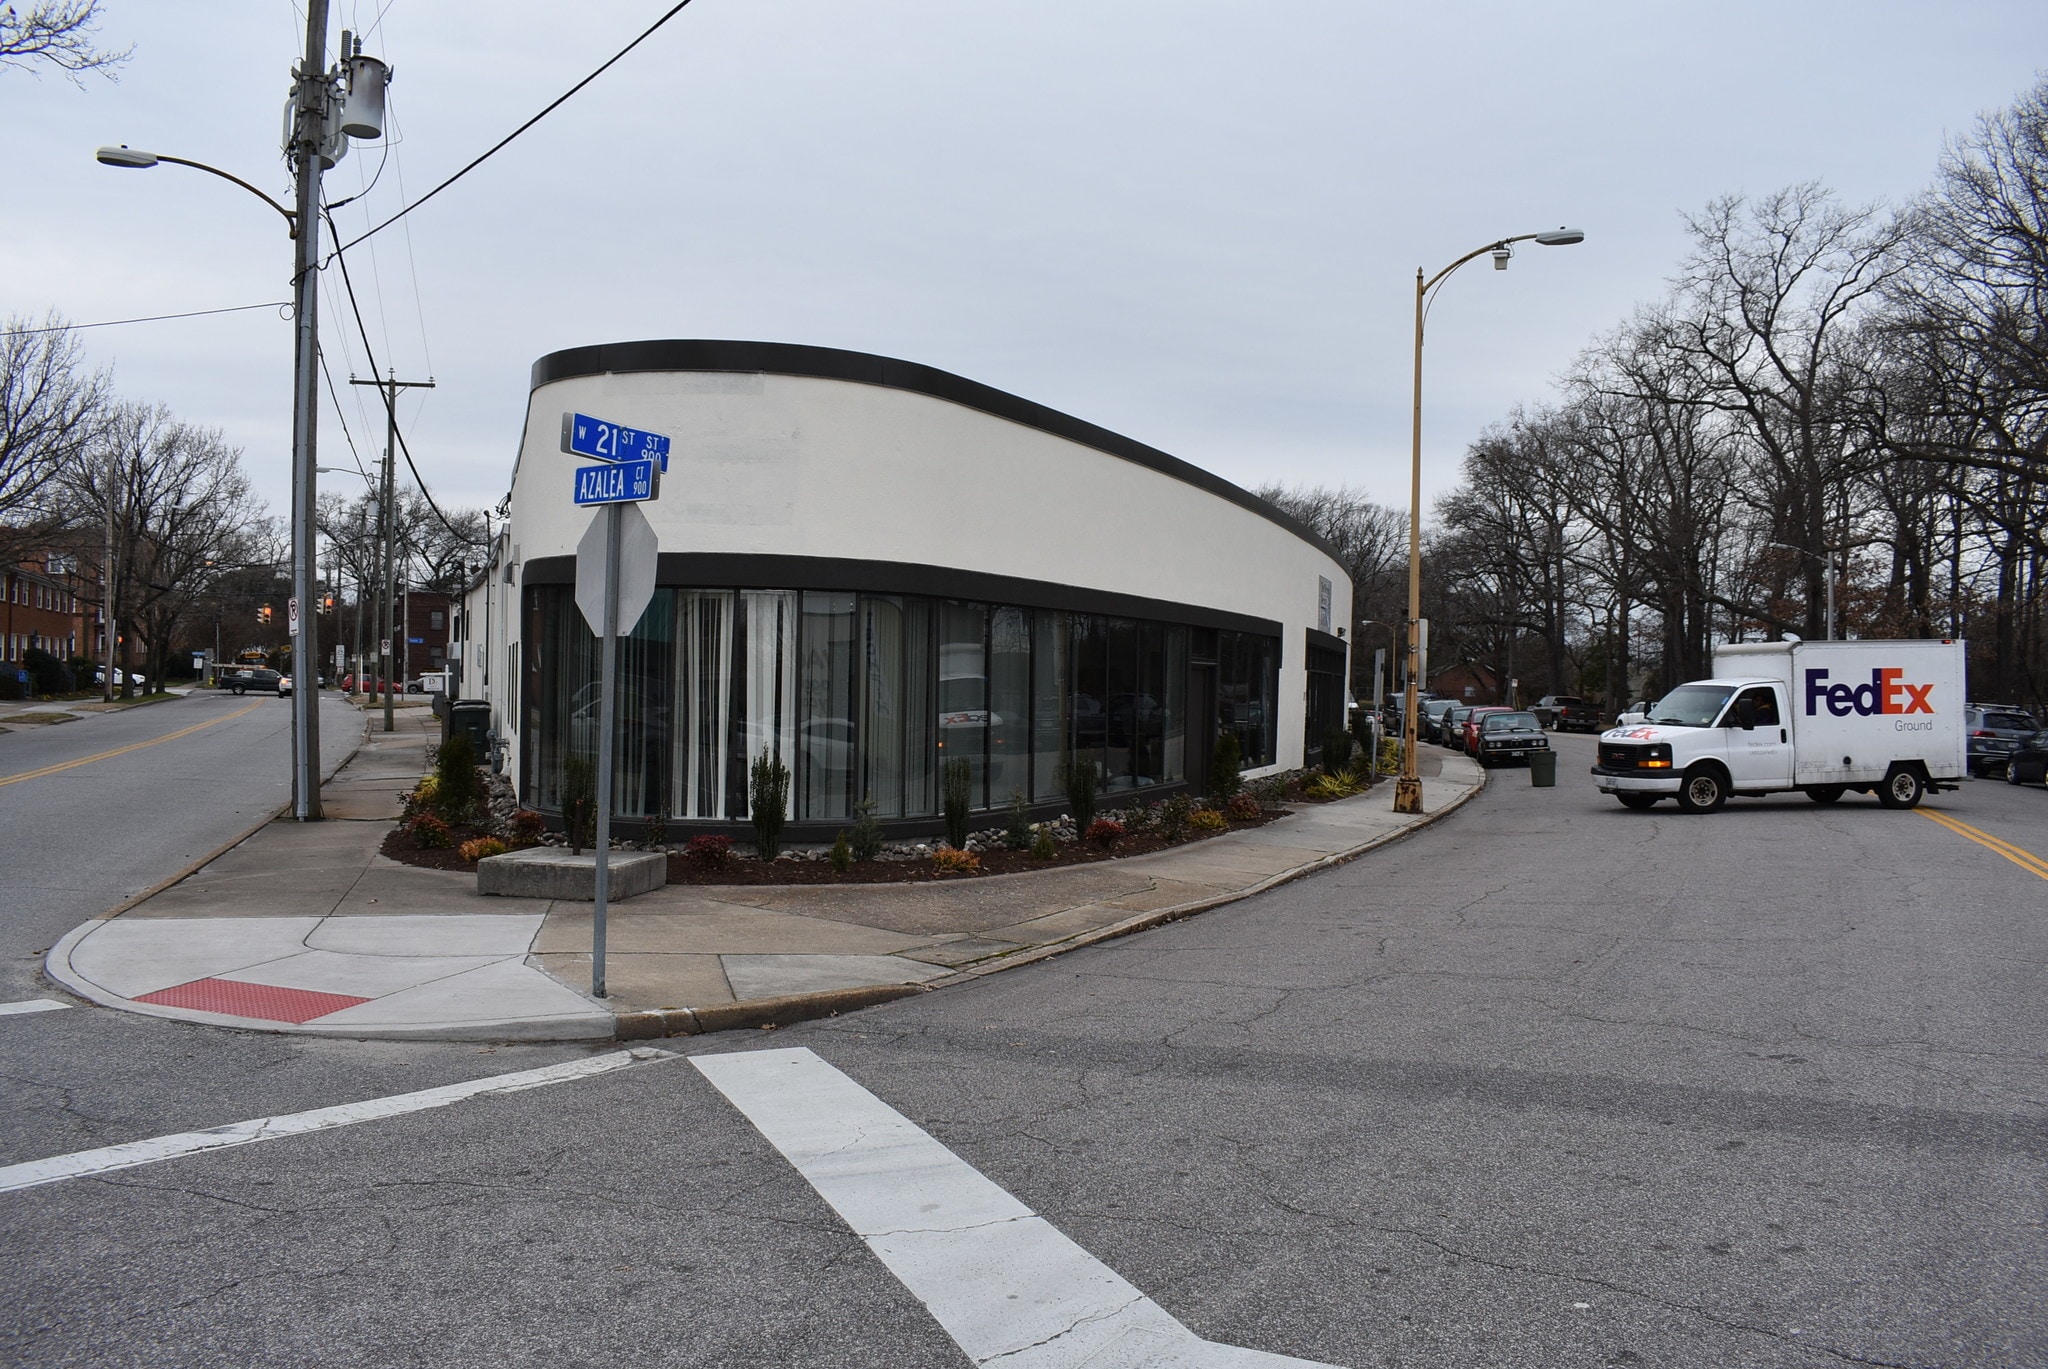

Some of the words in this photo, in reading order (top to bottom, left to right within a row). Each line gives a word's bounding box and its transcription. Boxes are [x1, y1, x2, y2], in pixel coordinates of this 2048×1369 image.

[578, 425, 587, 440] W
[646, 436, 659, 450] ST
[579, 469, 624, 500] AZALEA
[635, 466, 644, 480] CT
[633, 481, 647, 495] 900
[1805, 668, 1935, 717] FedEx
[1895, 720, 1933, 732] Ground
